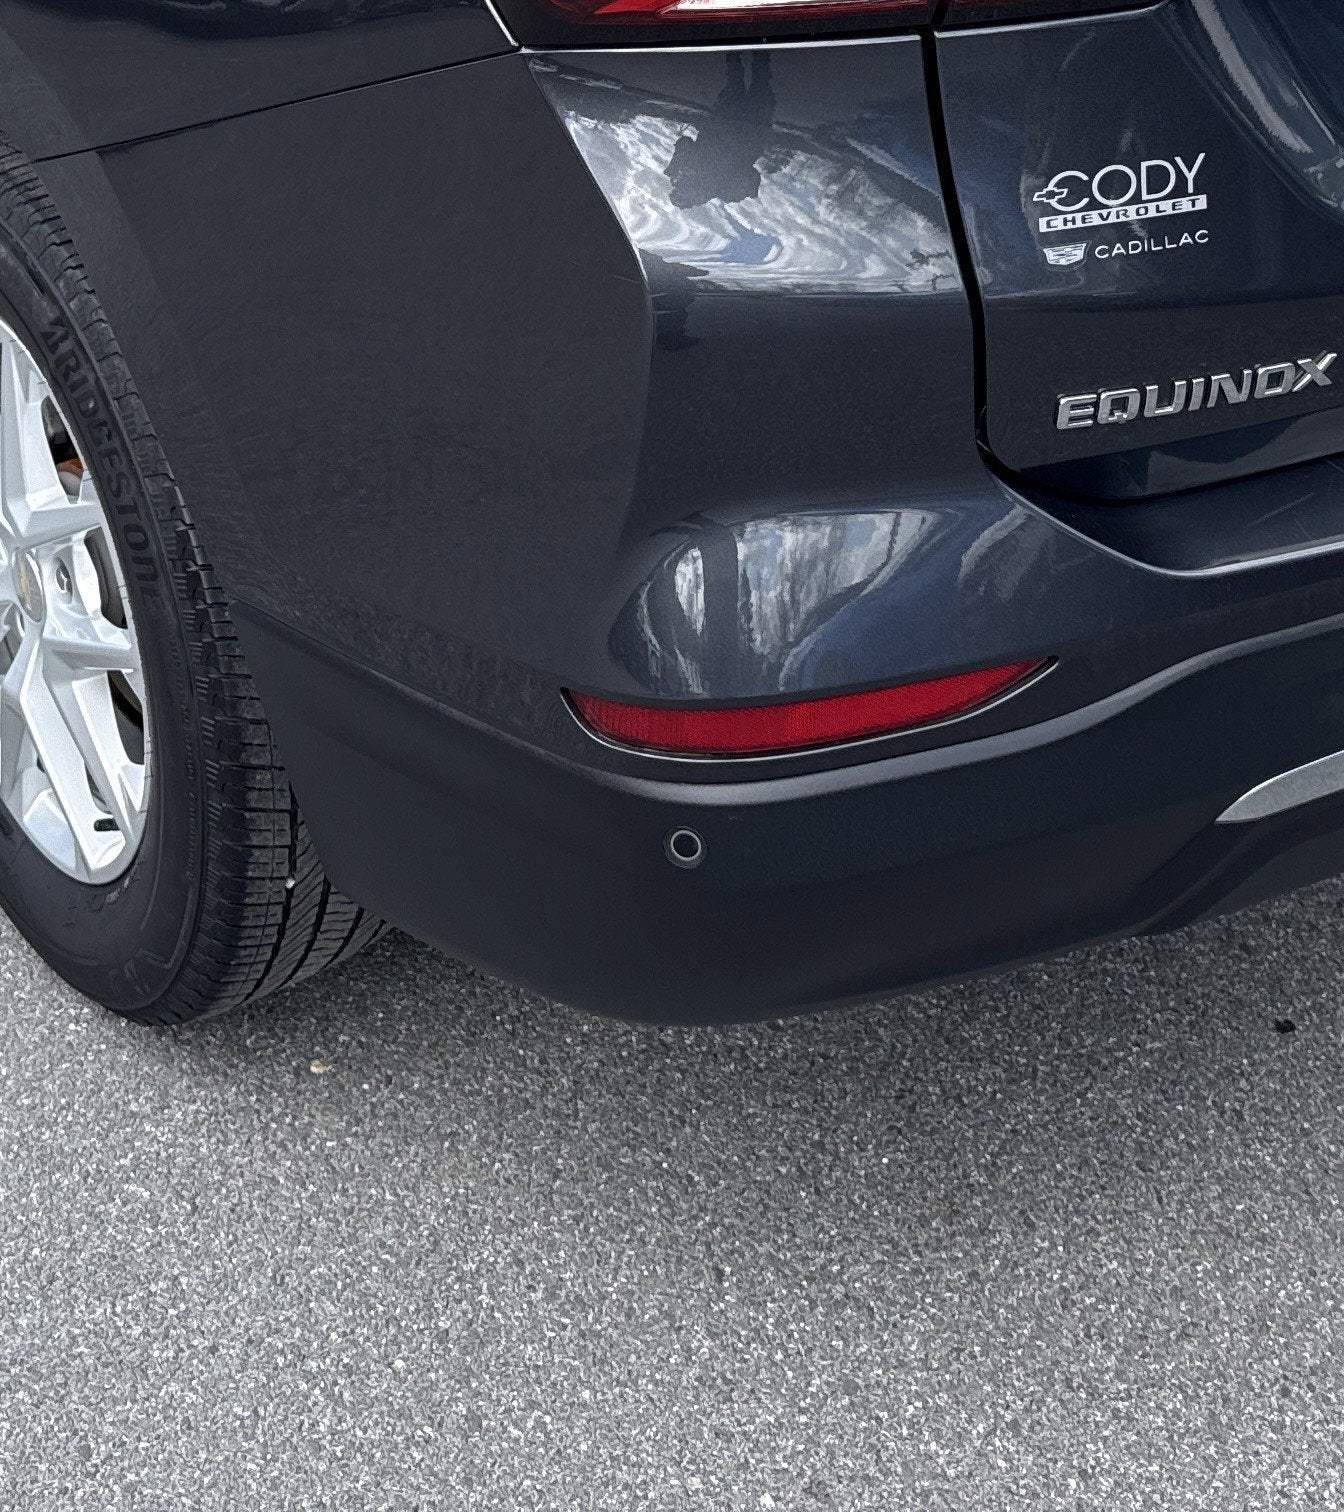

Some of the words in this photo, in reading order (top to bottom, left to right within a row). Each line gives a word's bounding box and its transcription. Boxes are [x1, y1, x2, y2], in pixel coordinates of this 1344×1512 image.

[1040, 152, 1206, 212] CODY
[1045, 196, 1202, 230] CHEVROLET
[1094, 229, 1210, 259] CADILLAC
[1054, 351, 1338, 431] EQUINOX
